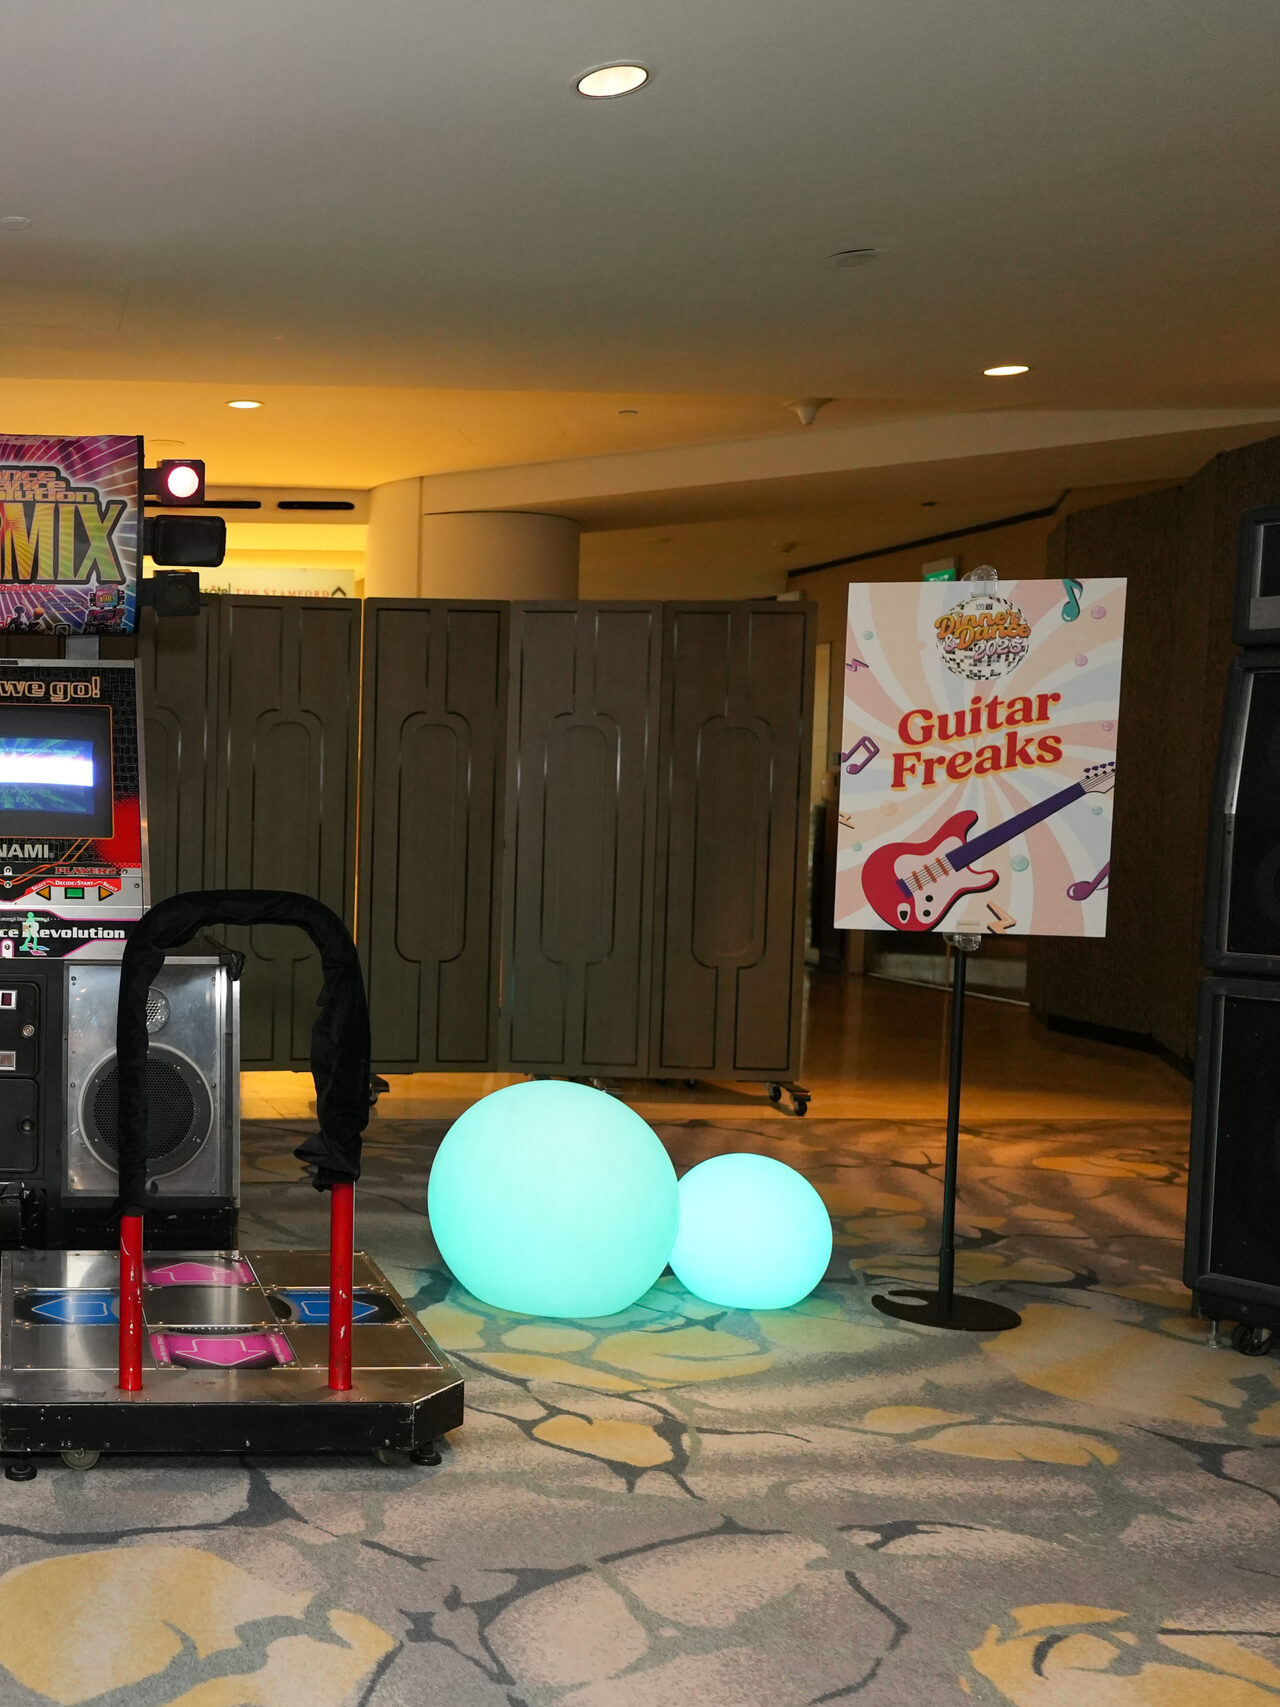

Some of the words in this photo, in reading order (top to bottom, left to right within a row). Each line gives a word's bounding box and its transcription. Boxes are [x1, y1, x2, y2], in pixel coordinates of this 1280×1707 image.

[934, 609, 1021, 639] Dinner
[954, 625, 1032, 650] Dance
[973, 639, 1023, 660] 2025
[49, 676, 101, 703] go!
[897, 692, 1062, 747] Guitar
[890, 730, 1064, 790] Freaks
[31, 880, 47, 891] SELECT
[103, 881, 118, 892] SELECT
[22, 921, 126, 939] Revolution
